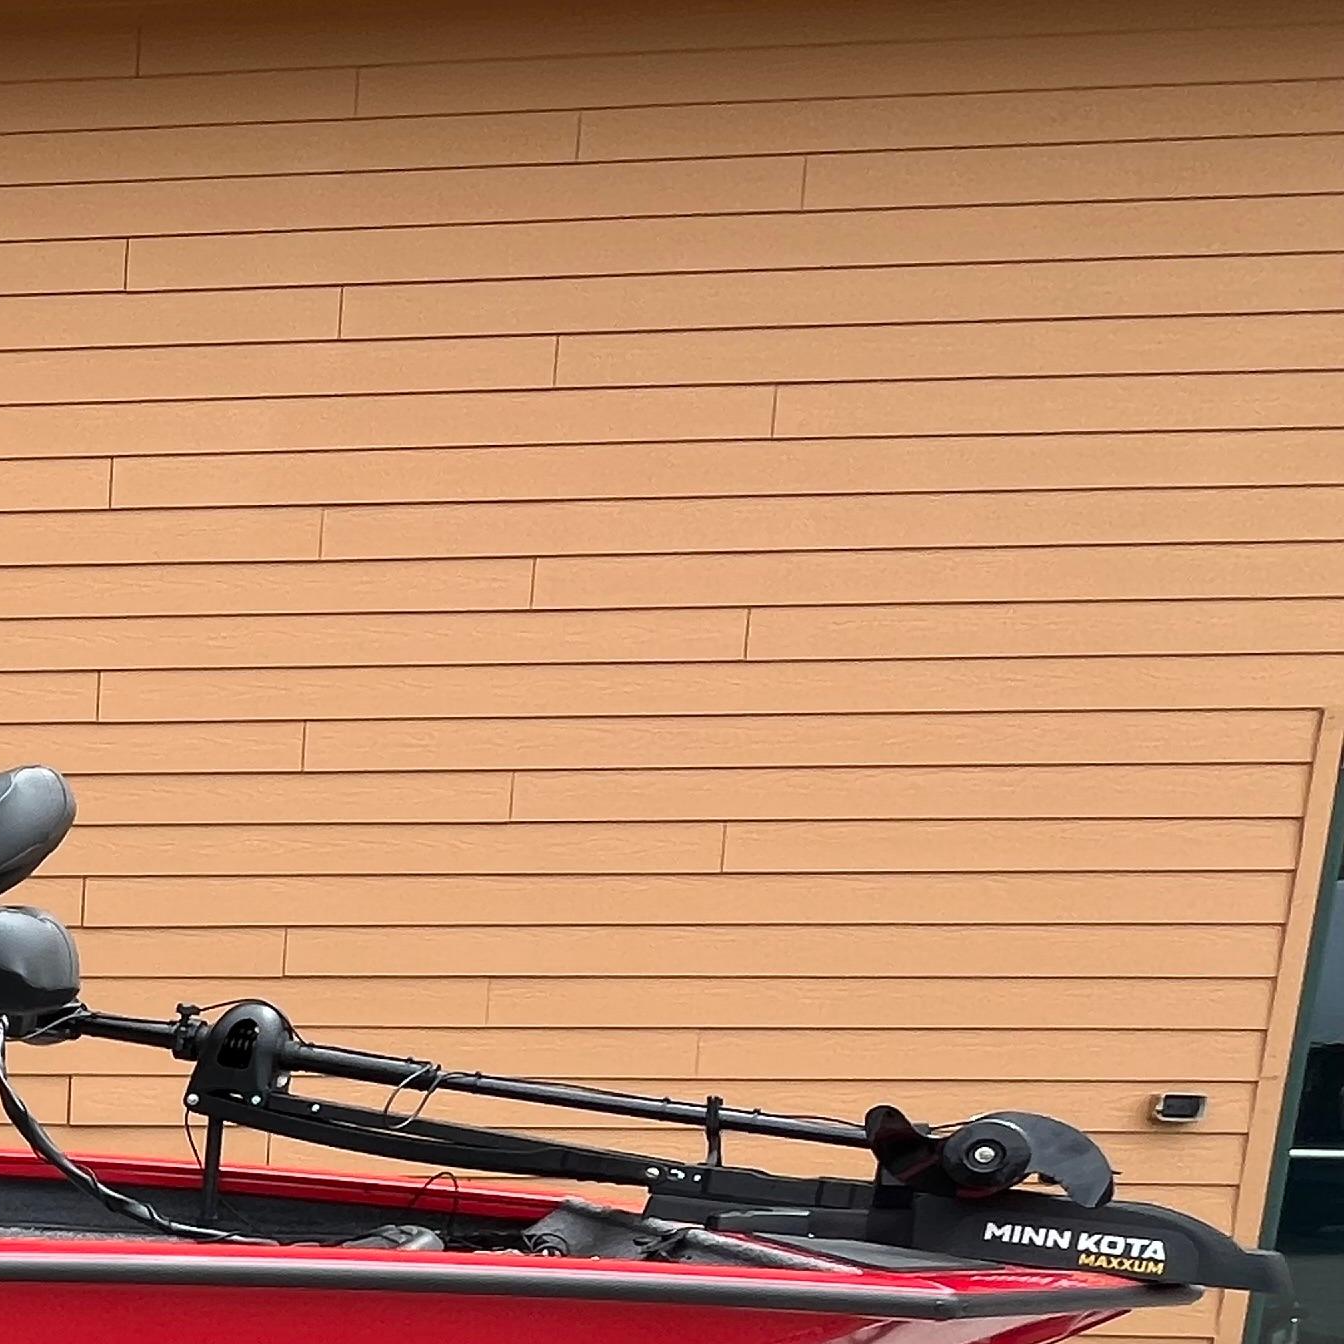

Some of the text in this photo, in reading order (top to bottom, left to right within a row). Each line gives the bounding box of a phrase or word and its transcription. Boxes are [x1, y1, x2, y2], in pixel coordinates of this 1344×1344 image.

[984, 1222, 1166, 1261] MINN KOTA
[1078, 1252, 1164, 1276] MAXXUM
